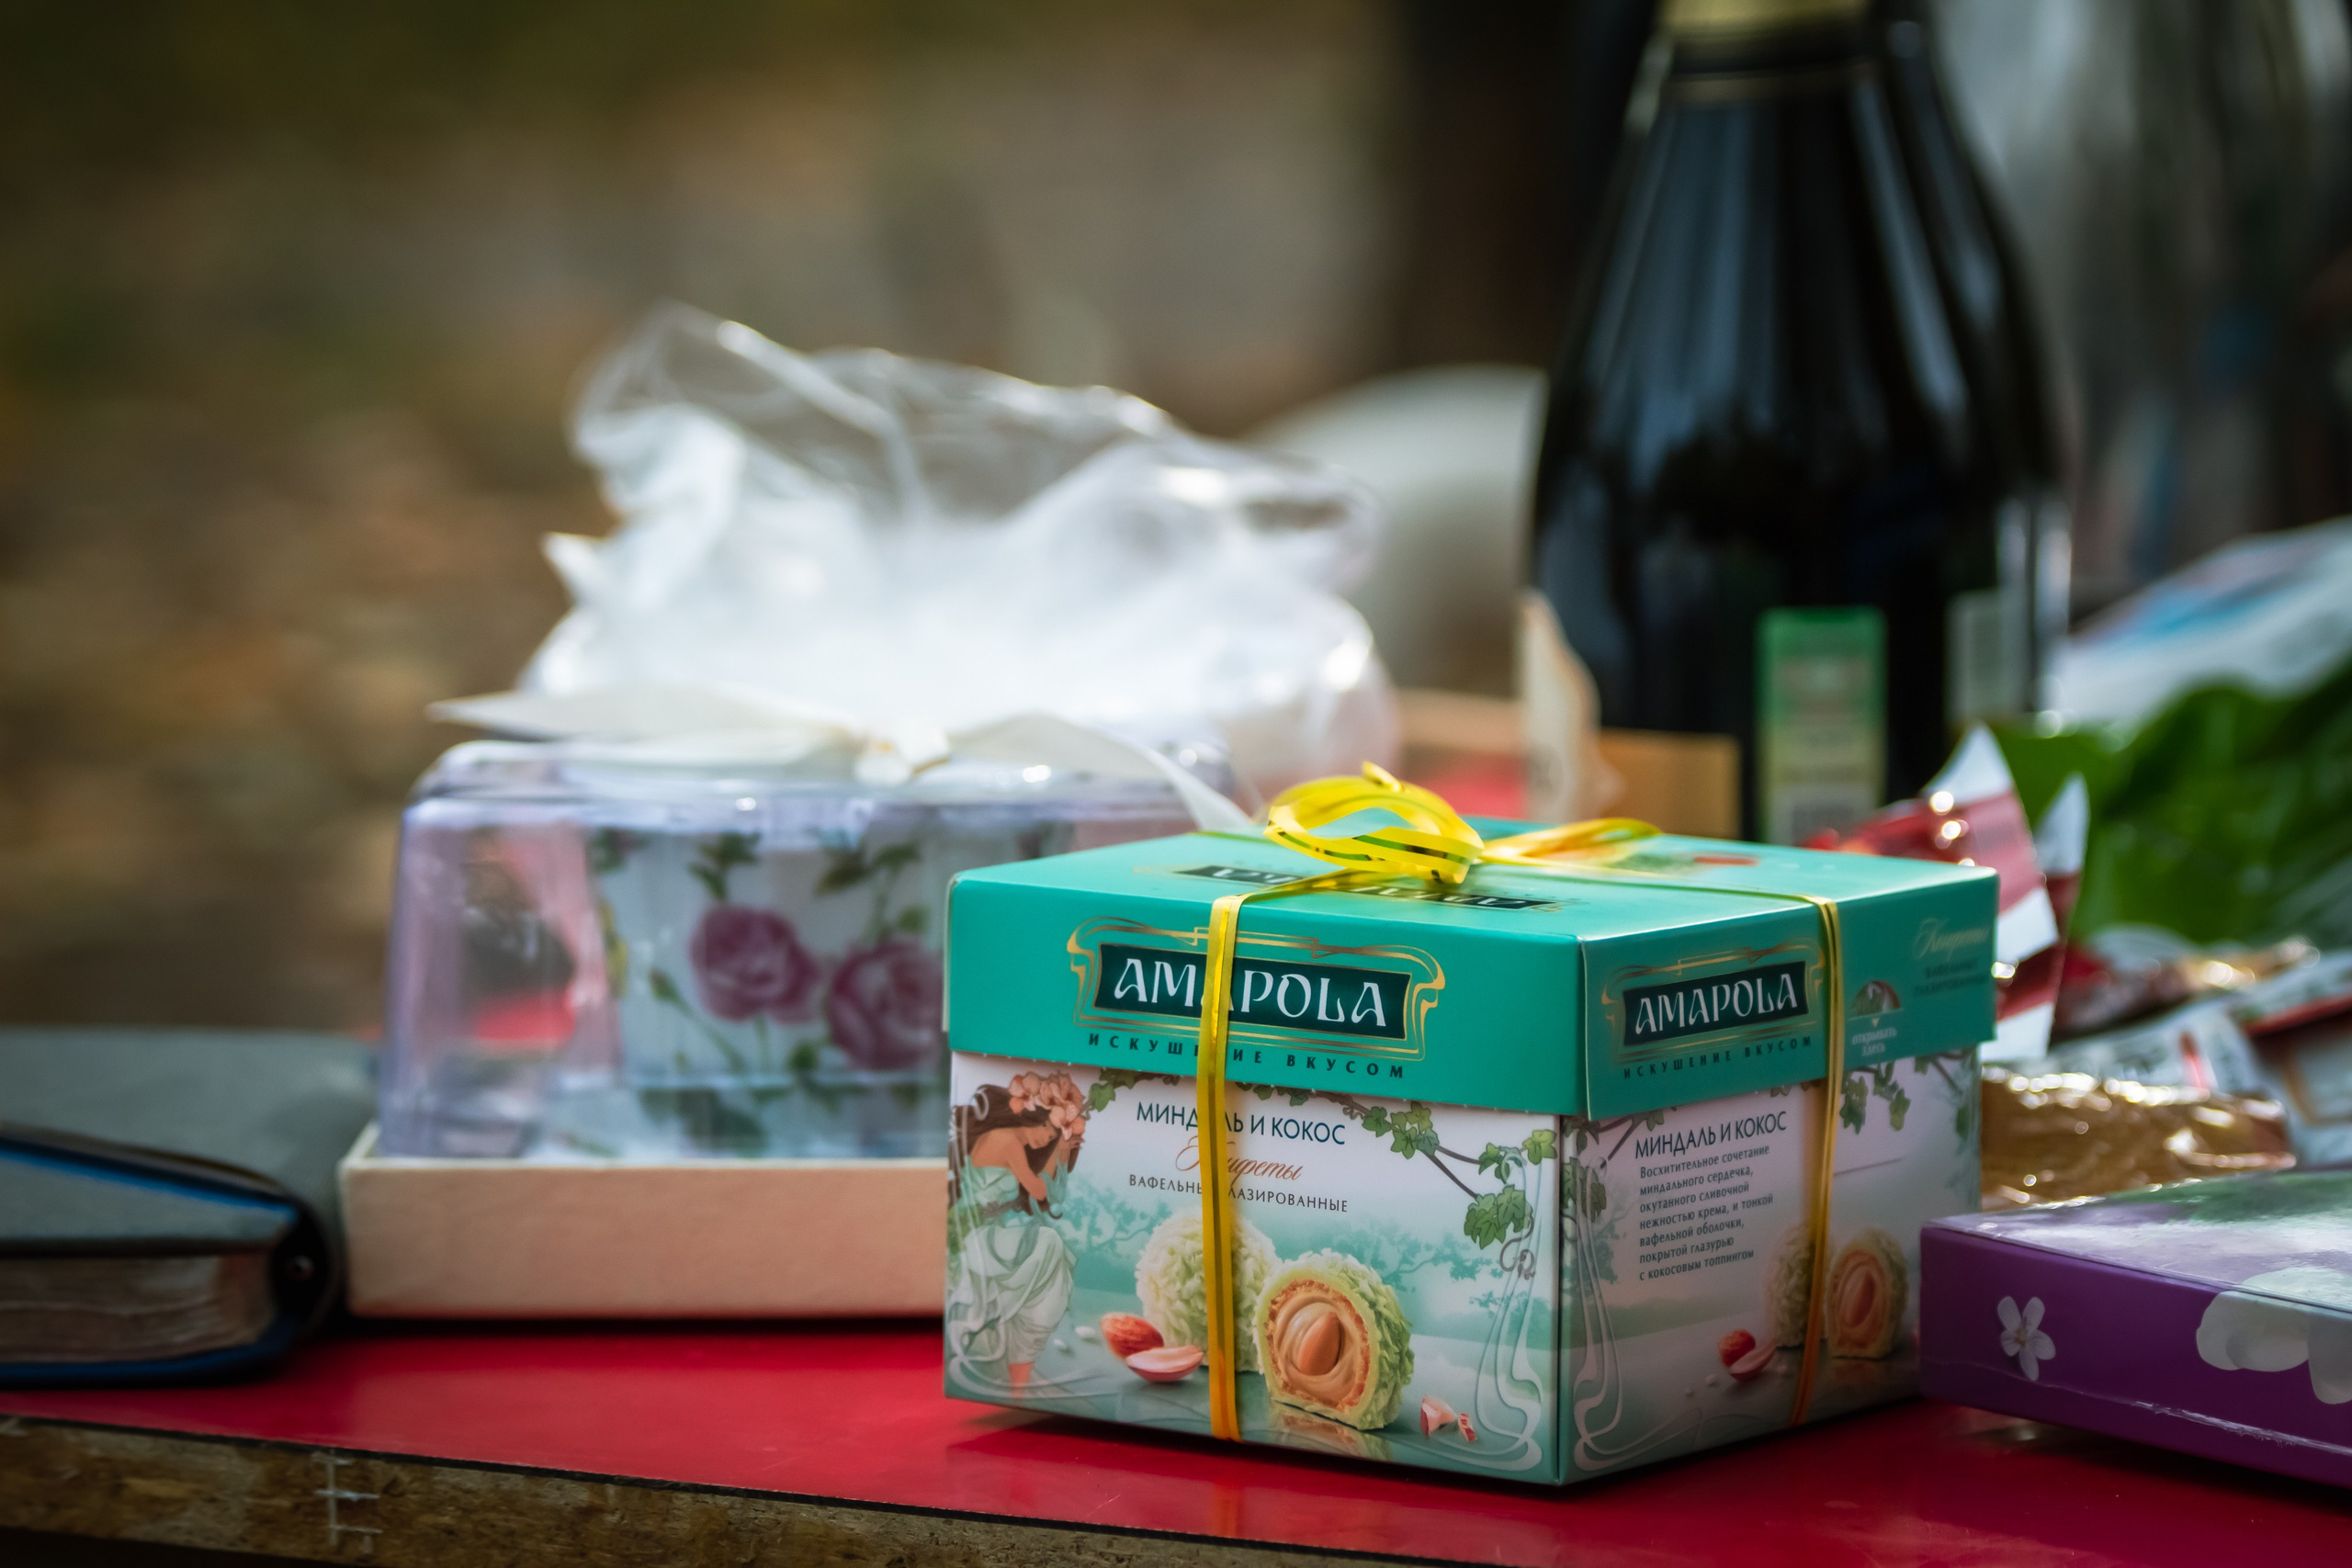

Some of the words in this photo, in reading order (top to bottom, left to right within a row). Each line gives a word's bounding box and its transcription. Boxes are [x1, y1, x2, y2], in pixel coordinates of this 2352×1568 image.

[1114, 957, 1386, 1027] AMPOLA
[1635, 973, 1798, 1034] AMAPOLA
[1286, 1055, 1404, 1078] ВКУСОМ
[1623, 1050, 1732, 1079] ИСКУШЕНИЕ
[1745, 1035, 1812, 1058] ВКУСОМ
[1136, 1100, 1244, 1133] МИНДЛЬ
[1250, 1114, 1265, 1136] И
[1272, 1117, 1346, 1145] КОКОС
[1634, 1126, 1716, 1159] МИНДАЛЬ
[1721, 1122, 1731, 1143] И
[1736, 1111, 1787, 1140] КОКОС
[1640, 1155, 1719, 1179] Восхитительное
[1722, 1145, 1770, 1163] сочетание
[1640, 1176, 1705, 1196] миндального
[1707, 1166, 1754, 1185] сердечка,
[1640, 1194, 1697, 1213] окутанного
[1699, 1182, 1749, 1201] сливочной
[1228, 1186, 1348, 1213] ЛАЗИРОВАННЫЕ
[1640, 1211, 1695, 1230] нежностью
[1698, 1204, 1730, 1223] крема,
[1732, 1202, 1738, 1212] и
[1741, 1193, 1773, 1209] тонкой
[1640, 1226, 1693, 1247] вафельной
[1696, 1217, 1744, 1235] оболочки,
[1639, 1271, 1645, 1281] с
[1647, 1260, 1702, 1280] кокосовым
[1704, 1249, 1755, 1268] топпингом
[1640, 1244, 1688, 1264] покрытой
[1690, 1236, 1735, 1255] глазурью
